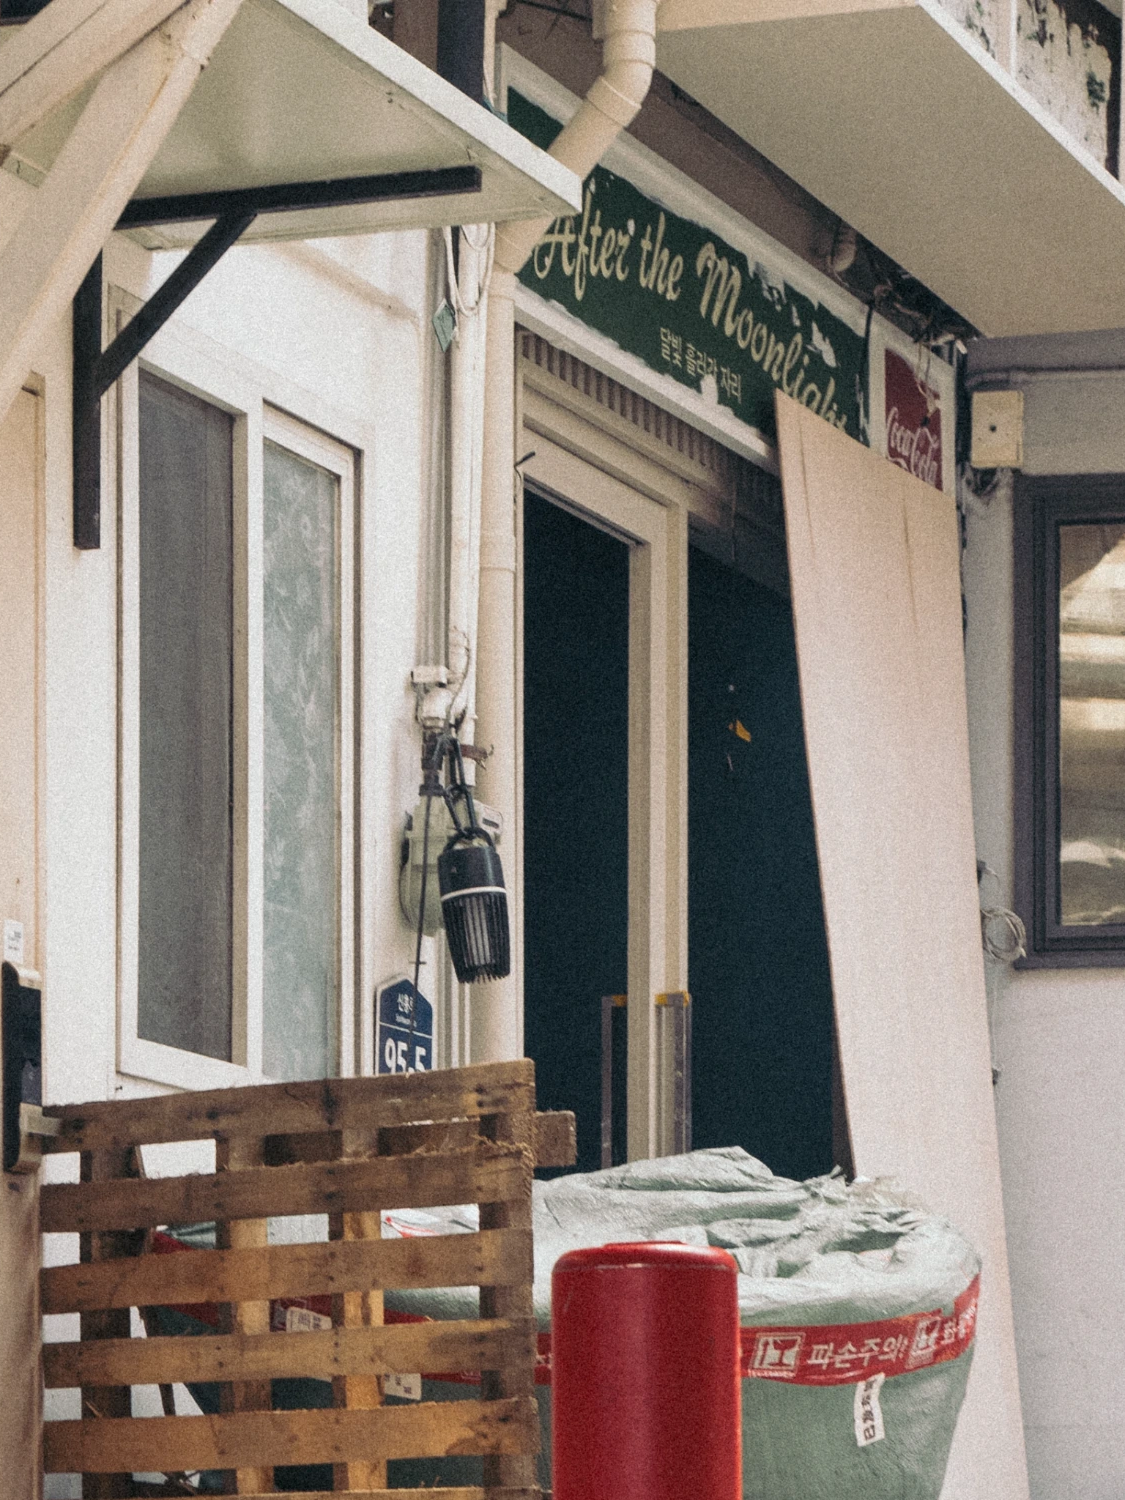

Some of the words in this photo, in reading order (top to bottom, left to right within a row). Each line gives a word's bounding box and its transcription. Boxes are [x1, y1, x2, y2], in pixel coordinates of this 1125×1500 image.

[533, 188, 632, 301] After
[639, 211, 683, 301] the
[719, 365, 742, 405] 자리
